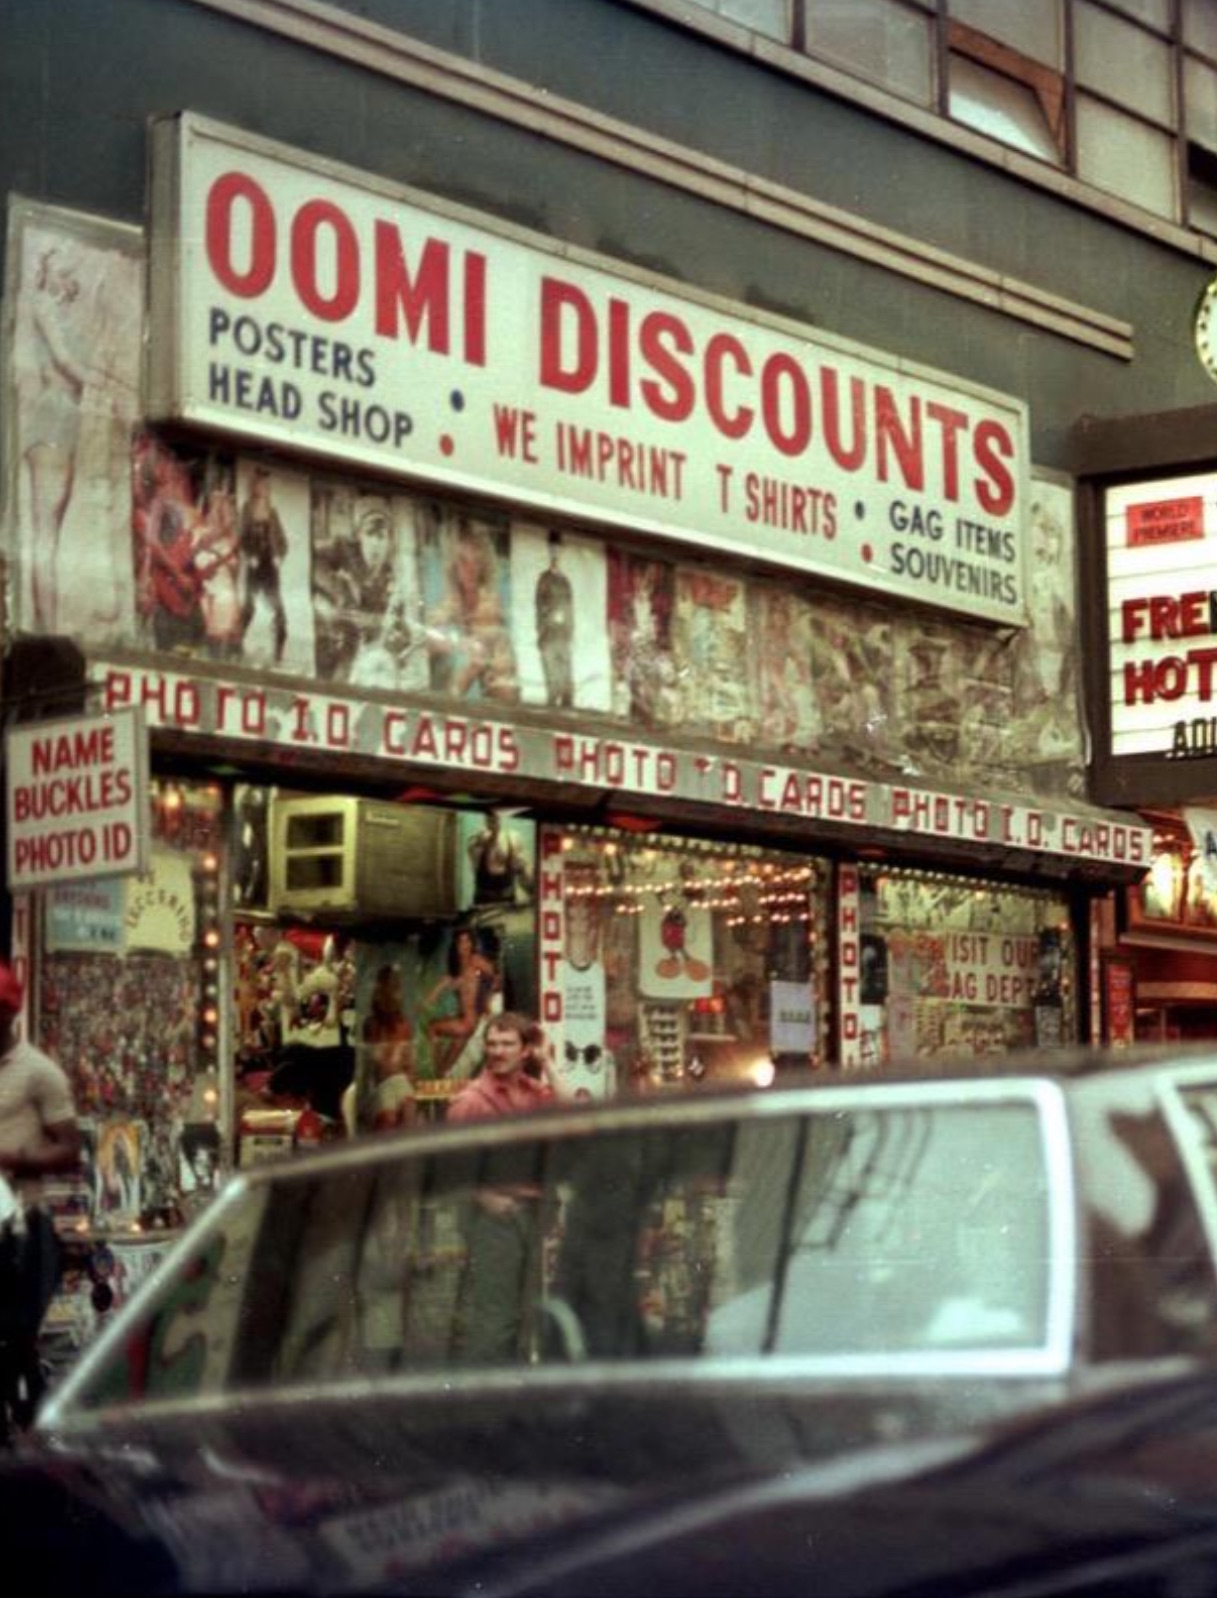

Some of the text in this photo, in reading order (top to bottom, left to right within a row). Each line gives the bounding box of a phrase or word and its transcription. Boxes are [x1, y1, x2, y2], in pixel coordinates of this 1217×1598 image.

[205, 171, 1016, 517] OOMI DISCOUNTS
[208, 307, 377, 388] POSTERS
[208, 364, 414, 450] HEAD SHOP
[492, 403, 838, 541] WE IMPRINT T SHIRTS
[889, 500, 1017, 563] GAG ITEMS
[889, 543, 1018, 605] SOUVENIRS
[30, 725, 115, 778] NAME
[104, 670, 267, 736] PHOTO
[382, 709, 522, 772] CARDS
[13, 770, 133, 824] BUCKLES
[553, 737, 677, 792] PHOTO
[757, 768, 866, 821] CARDS
[15, 822, 132, 875] PHOTO ID
[891, 789, 987, 840] PHOTO
[1062, 819, 1145, 862] CARDS
[543, 833, 562, 1022] PHOTO
[842, 870, 858, 1039] PHOTO
